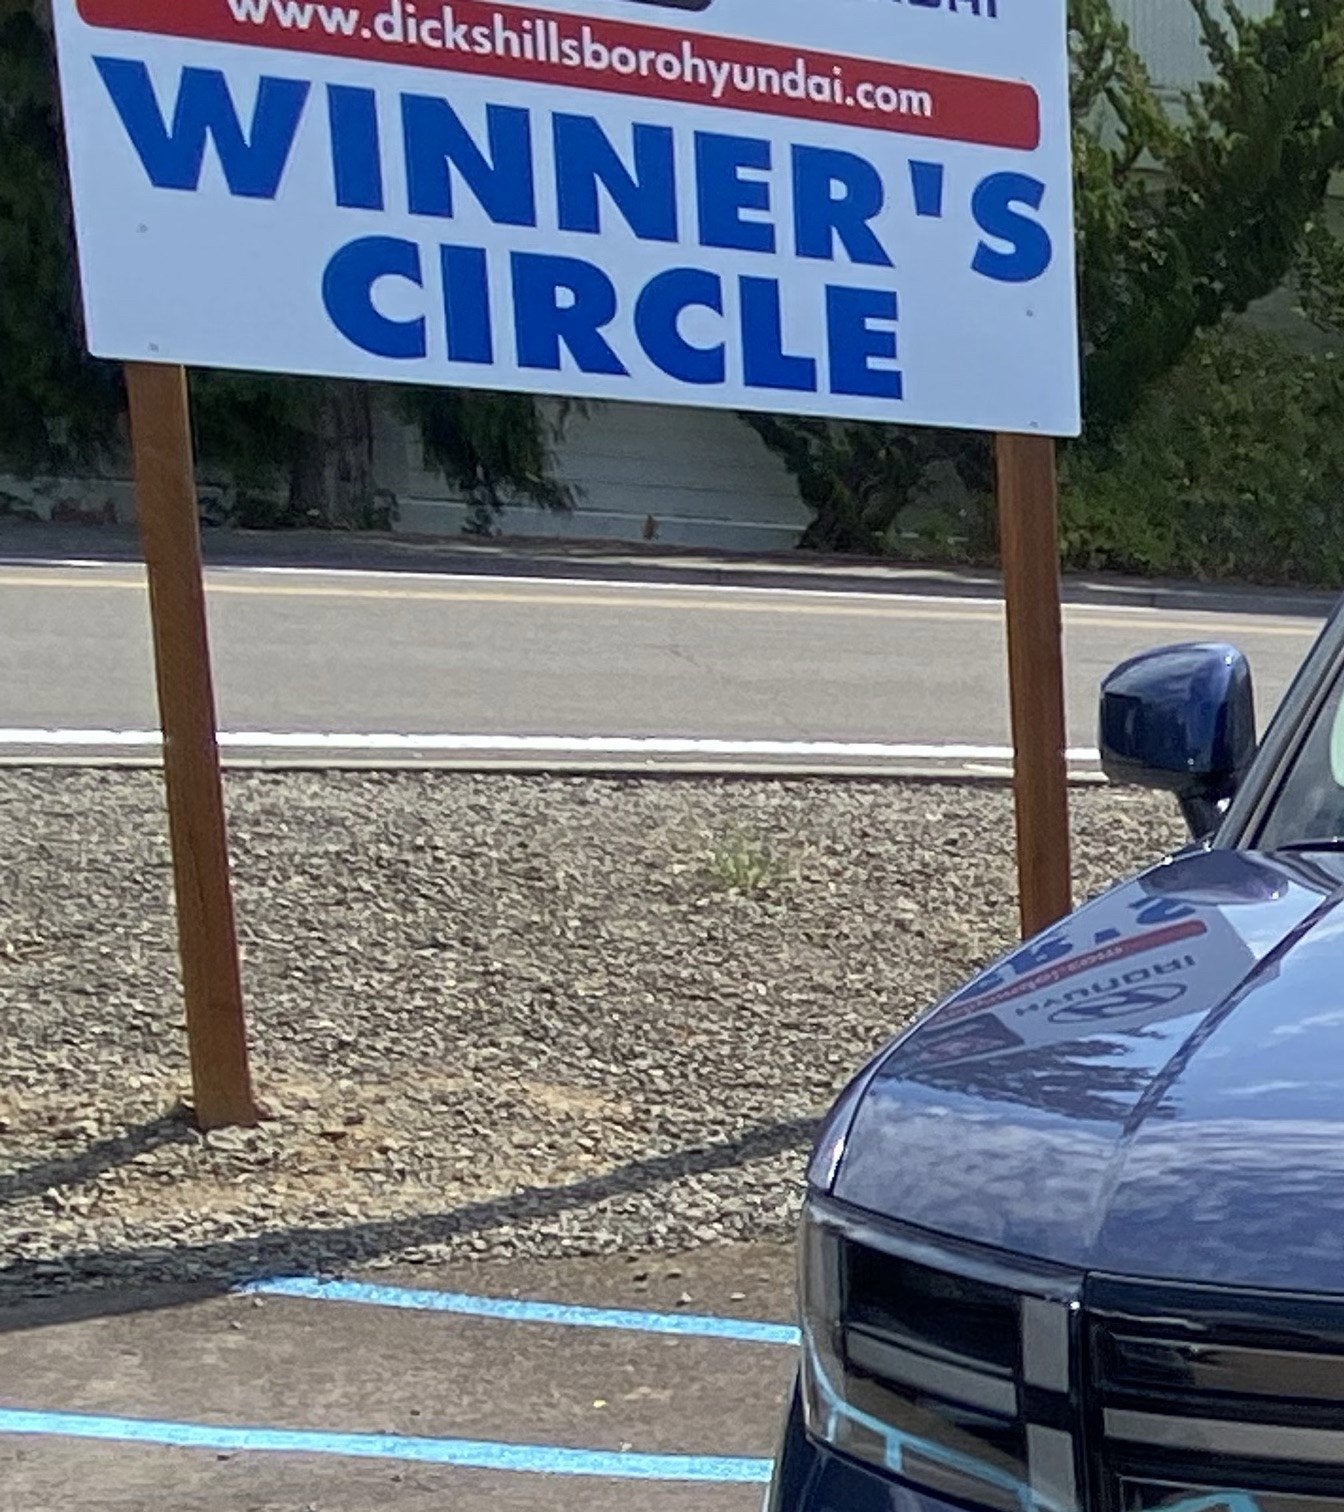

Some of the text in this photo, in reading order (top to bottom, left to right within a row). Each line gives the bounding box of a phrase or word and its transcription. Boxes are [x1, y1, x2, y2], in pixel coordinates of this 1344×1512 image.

[225, 0, 933, 117] www.dickshillsborohyundai.com
[92, 56, 1054, 283] WINNER'S
[321, 235, 904, 401] CIRCLE
